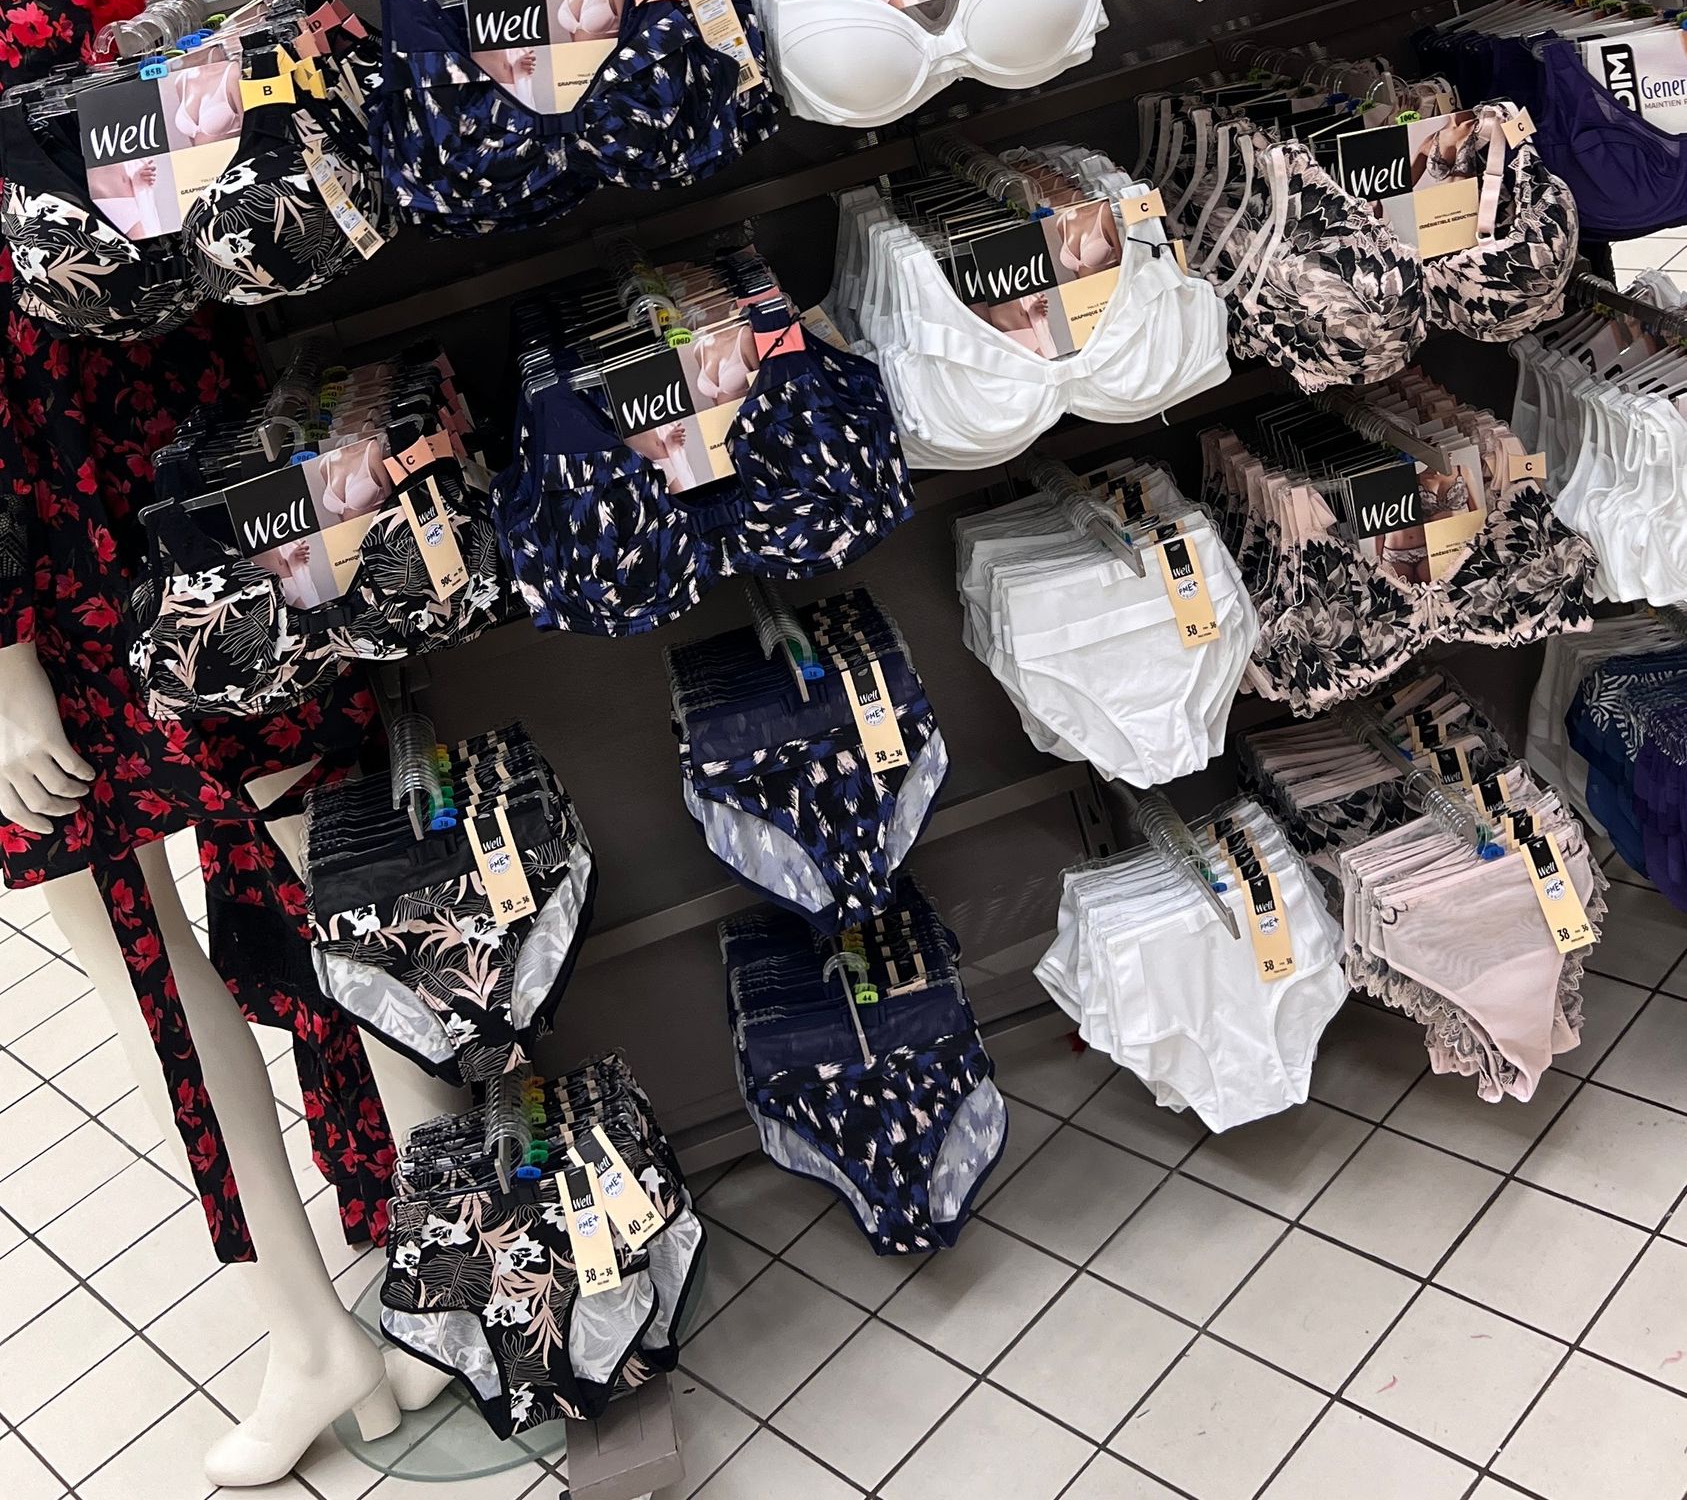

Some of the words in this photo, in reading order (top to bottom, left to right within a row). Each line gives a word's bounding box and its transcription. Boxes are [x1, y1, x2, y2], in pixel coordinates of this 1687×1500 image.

[475, 5, 542, 45] Well
[145, 68, 162, 77] 85B
[263, 85, 272, 96] B
[1518, 123, 1524, 132] C
[90, 112, 160, 159] Well
[1350, 156, 1407, 200] Well
[1140, 202, 1149, 213] C
[988, 253, 1049, 298] Well
[672, 337, 691, 345] 100D
[621, 380, 686, 430] Well
[406, 455, 415, 465] C
[1524, 462, 1533, 472] C
[418, 506, 436, 524] Well
[1361, 493, 1416, 532] Well
[243, 498, 310, 549] Well
[1173, 564, 1192, 577] Well
[1186, 624, 1198, 637] 38
[860, 690, 878, 704] Well
[875, 751, 887, 762] 38
[1444, 771, 1461, 783] Well
[482, 836, 502, 852] Well
[1538, 862, 1556, 877] Well
[500, 899, 513, 913] 38
[1256, 901, 1274, 913] Well
[1557, 927, 1570, 941] 38
[1263, 960, 1274, 972] 38
[573, 1194, 593, 1210] Well
[628, 1219, 641, 1236] 40
[585, 1269, 597, 1283] 38
